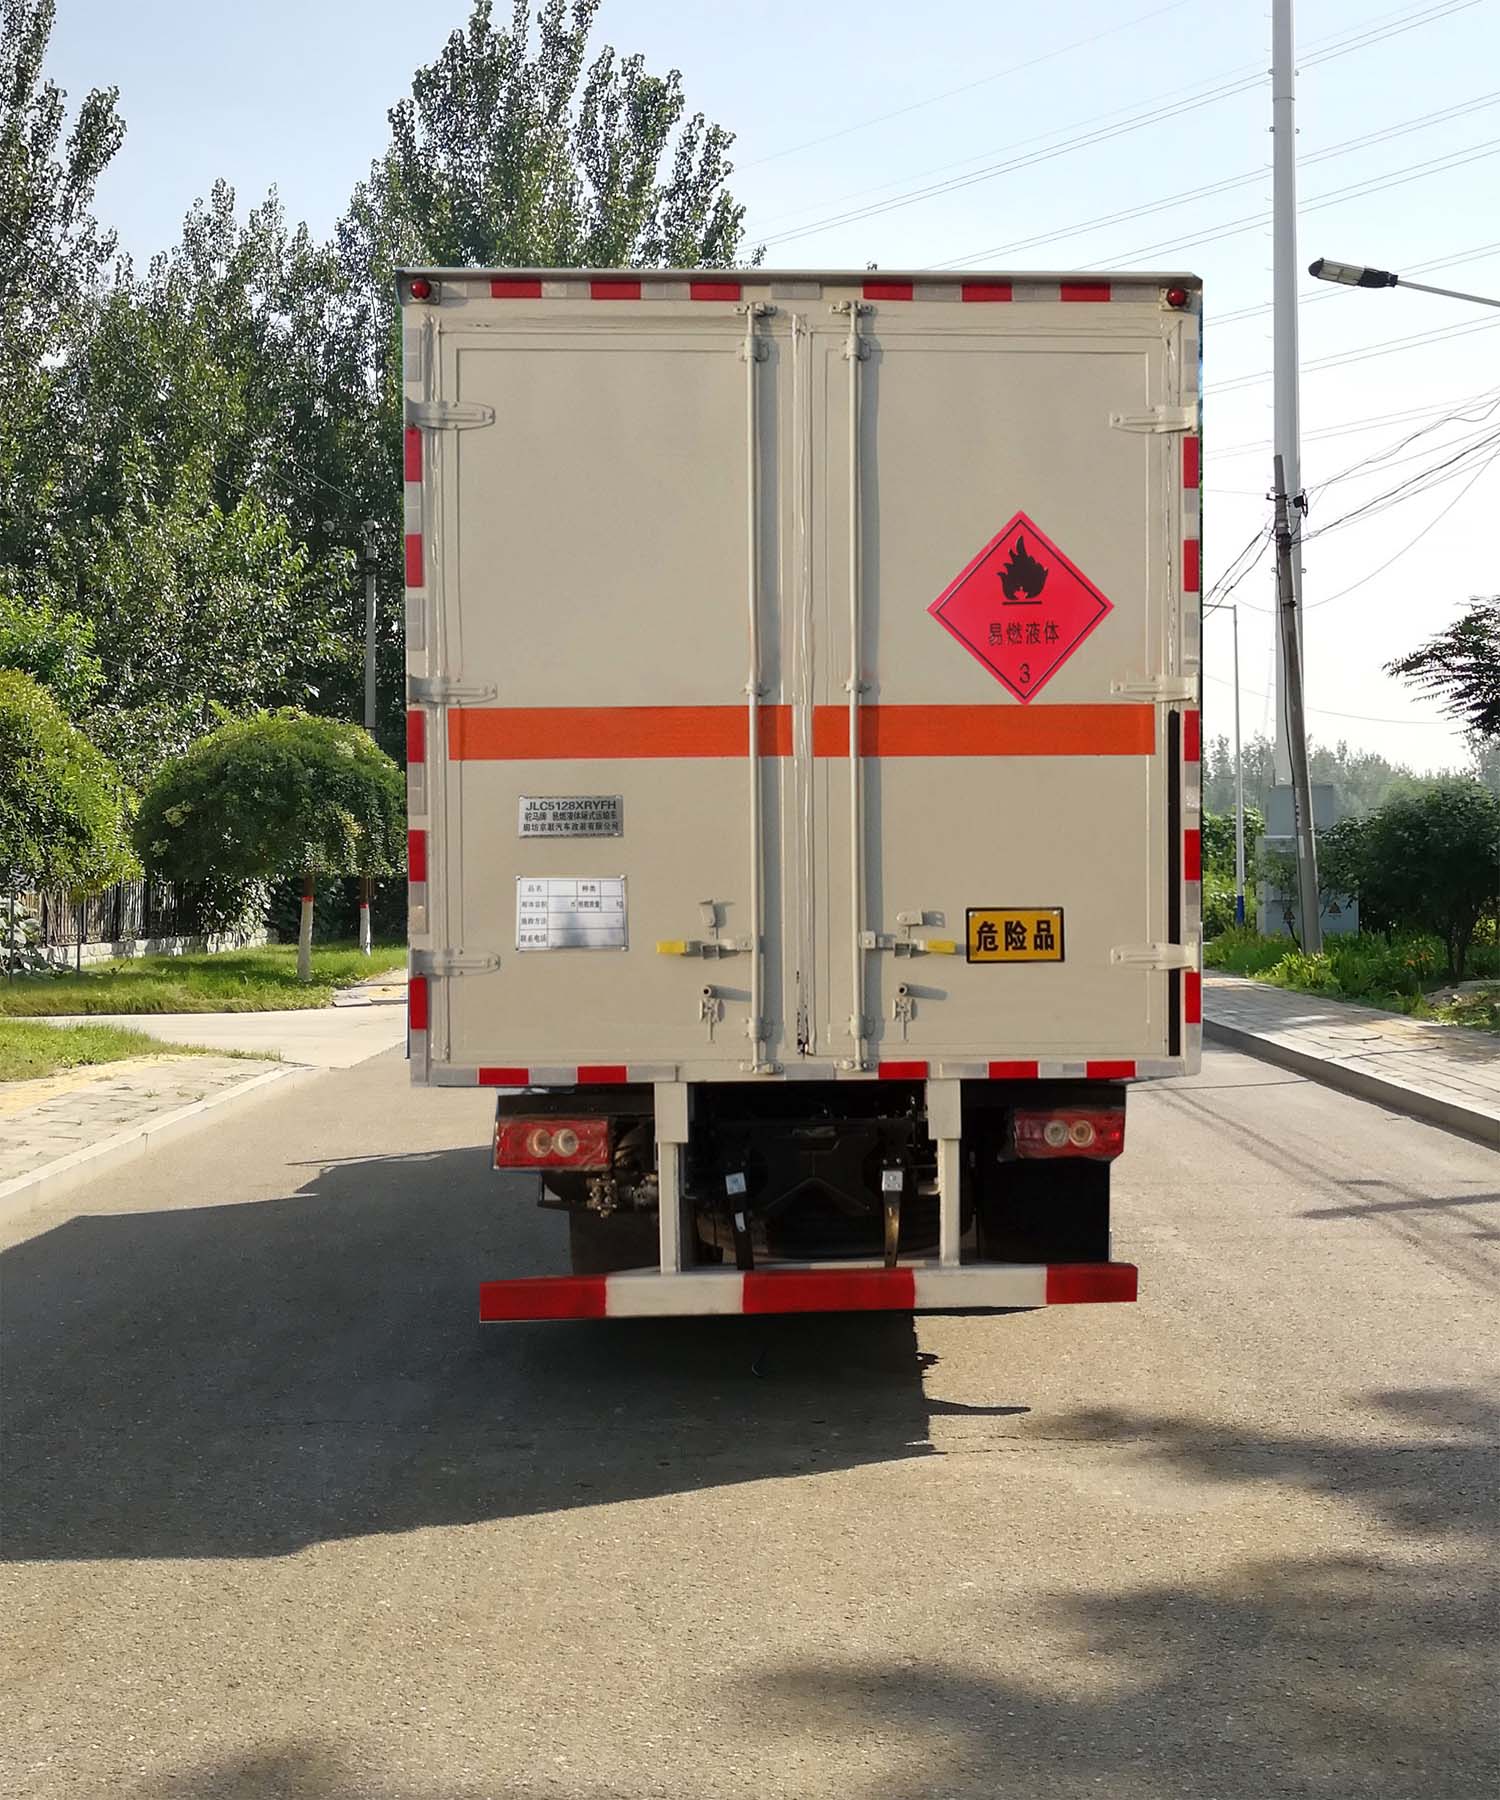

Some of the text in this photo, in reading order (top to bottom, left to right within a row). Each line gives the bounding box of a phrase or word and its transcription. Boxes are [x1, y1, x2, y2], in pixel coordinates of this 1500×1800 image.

[989, 621, 1059, 646] 易燃液体
[1019, 663, 1031, 684] 3
[526, 800, 617, 811] JLC5128XRYFH
[976, 920, 1055, 952] 危险品
